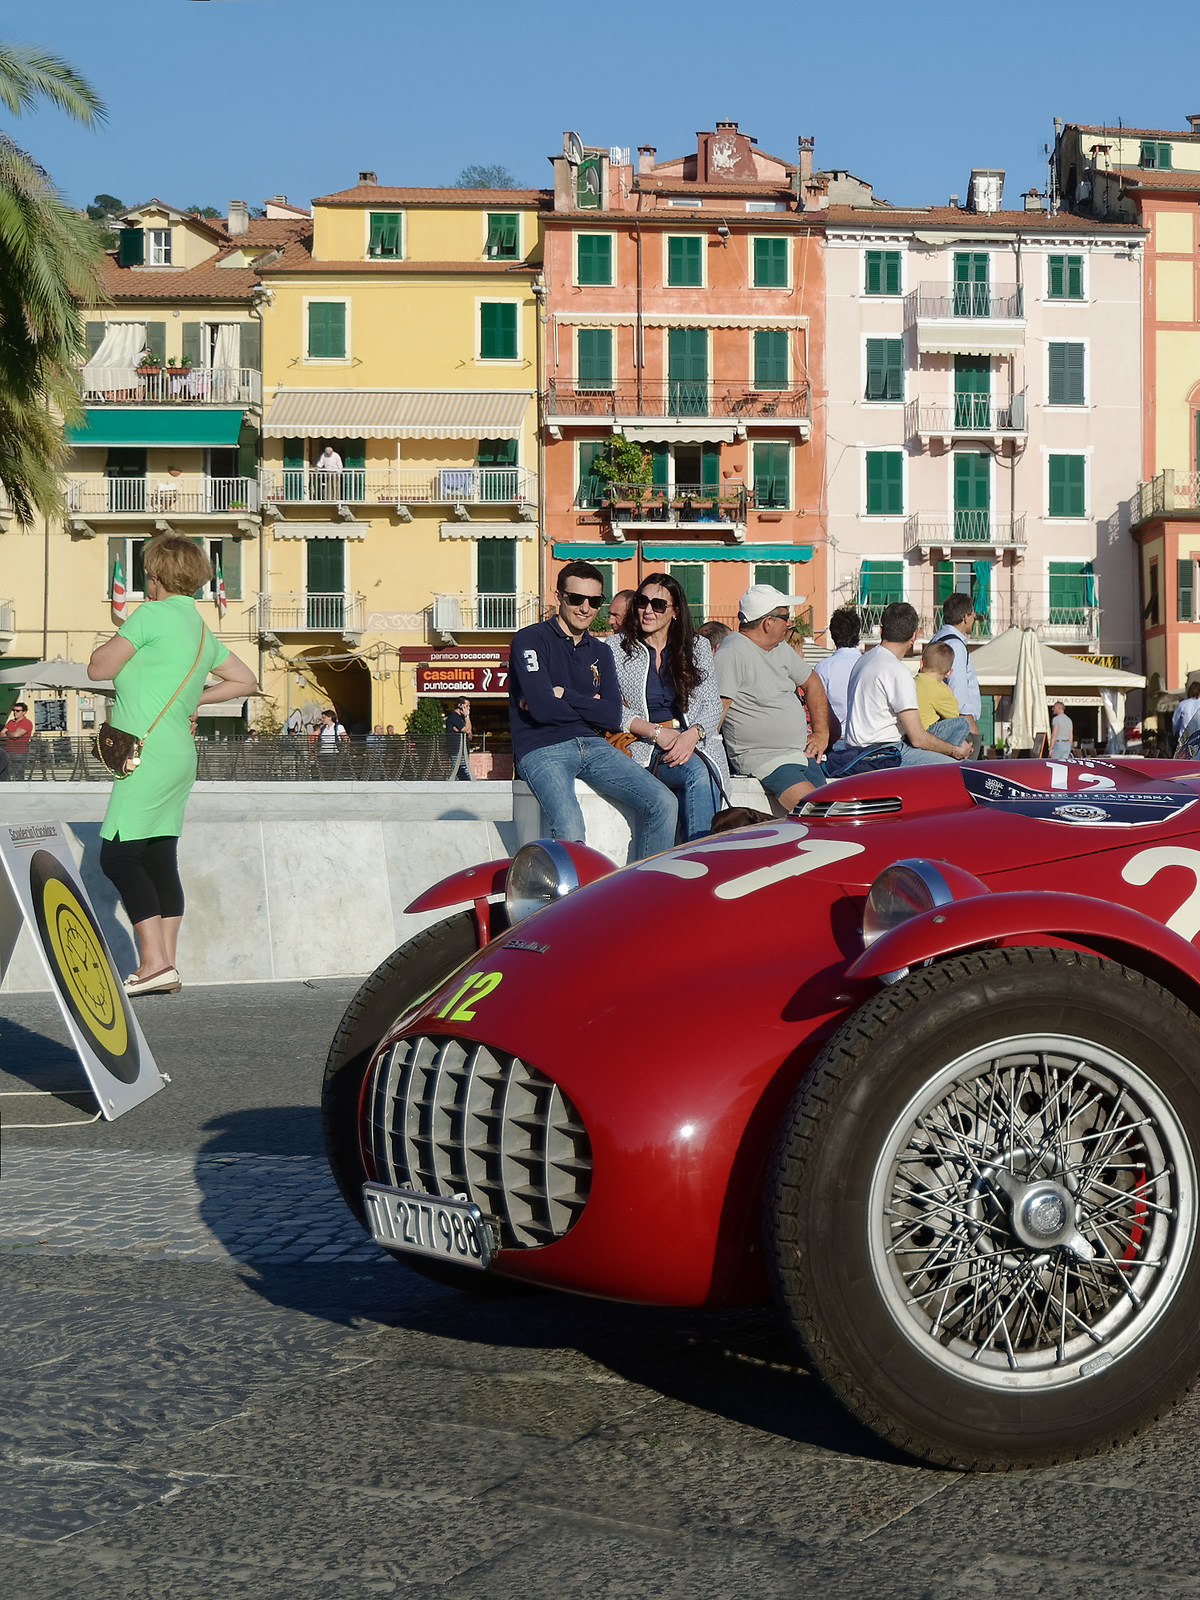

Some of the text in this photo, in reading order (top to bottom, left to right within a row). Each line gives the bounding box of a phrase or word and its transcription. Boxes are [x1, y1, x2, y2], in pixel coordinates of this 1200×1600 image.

[523, 649, 540, 673] 3
[423, 668, 475, 681] casalini
[423, 681, 475, 692] puntocaldo
[1046, 761, 1117, 791] 12
[437, 971, 503, 1022] 12
